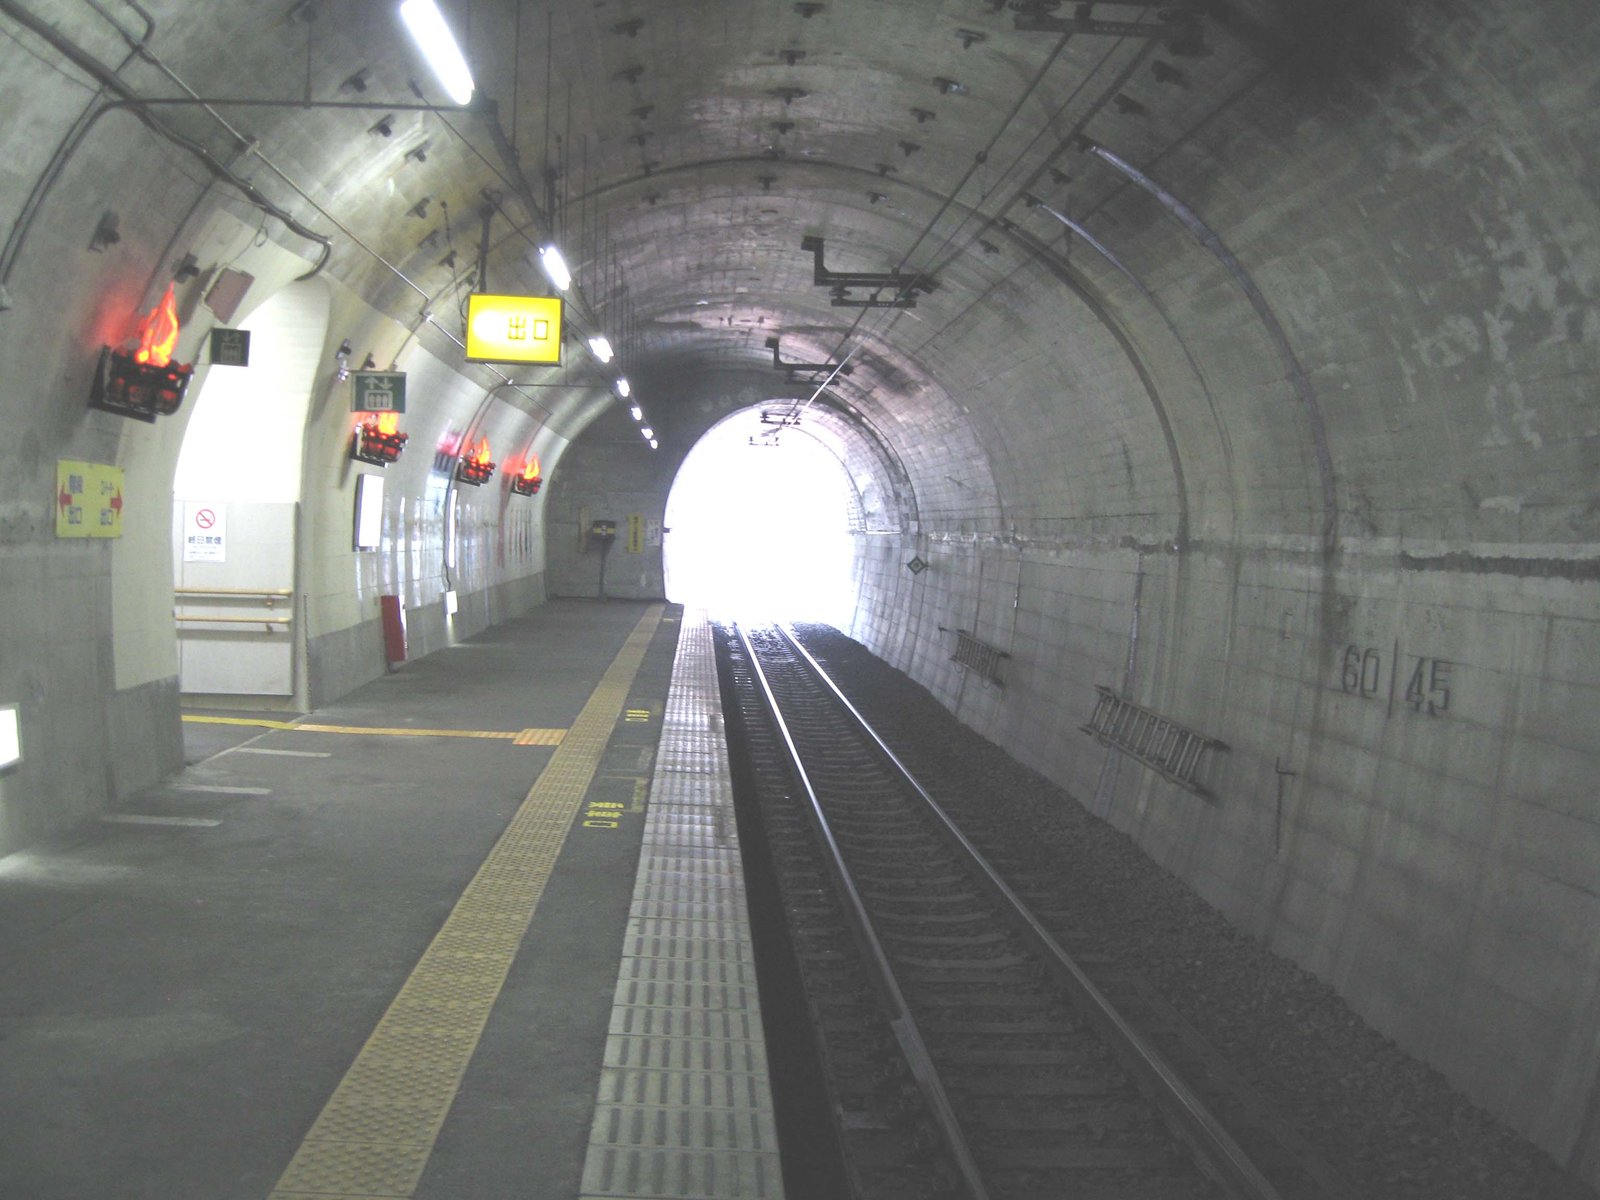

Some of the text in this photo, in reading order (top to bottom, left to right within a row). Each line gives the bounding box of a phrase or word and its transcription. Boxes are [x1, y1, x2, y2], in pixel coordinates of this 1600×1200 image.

[508, 315, 549, 341] 出口
[1341, 644, 1452, 718] 60 45
